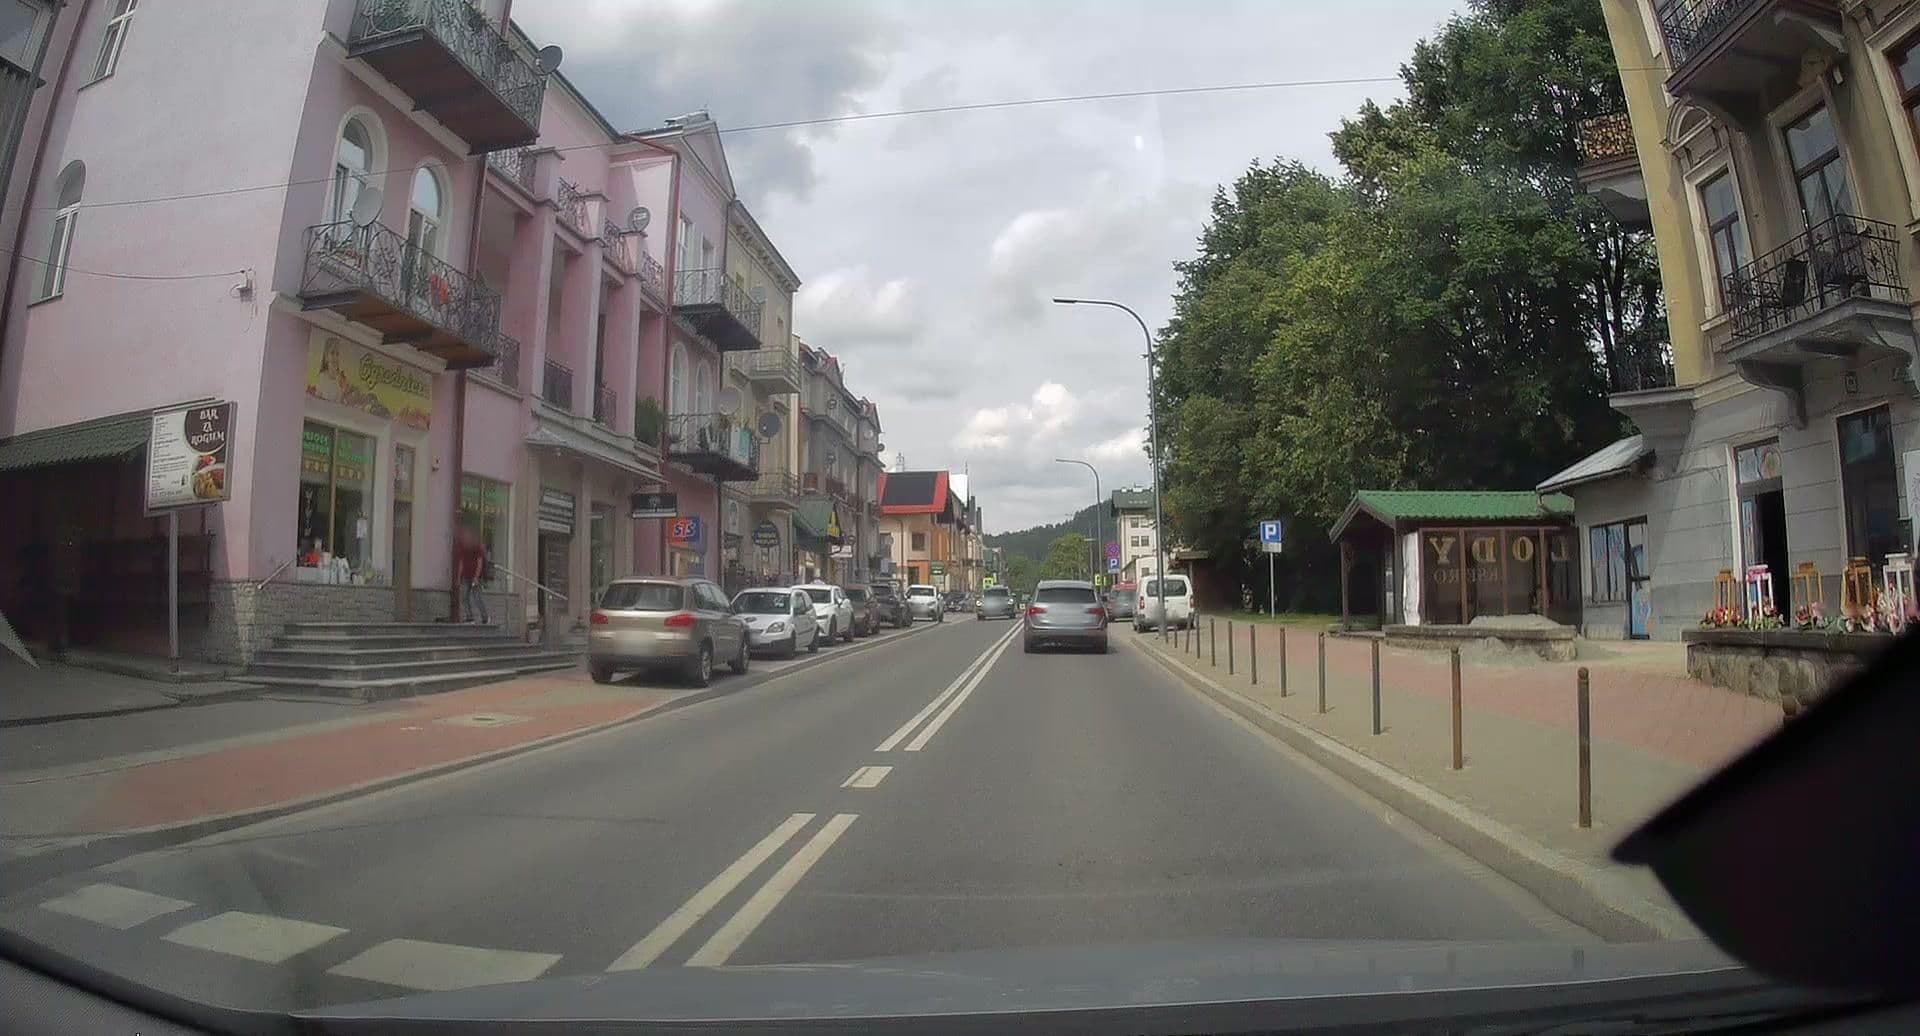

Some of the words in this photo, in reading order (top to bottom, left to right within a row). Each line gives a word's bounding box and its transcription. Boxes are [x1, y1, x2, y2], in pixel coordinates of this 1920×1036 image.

[199, 408, 219, 420] BAR
[202, 421, 213, 432] ZA
[191, 431, 225, 446] ROGIEM
[673, 522, 697, 538] STS
[1265, 523, 1277, 540] P
[1110, 559, 1118, 568] P
